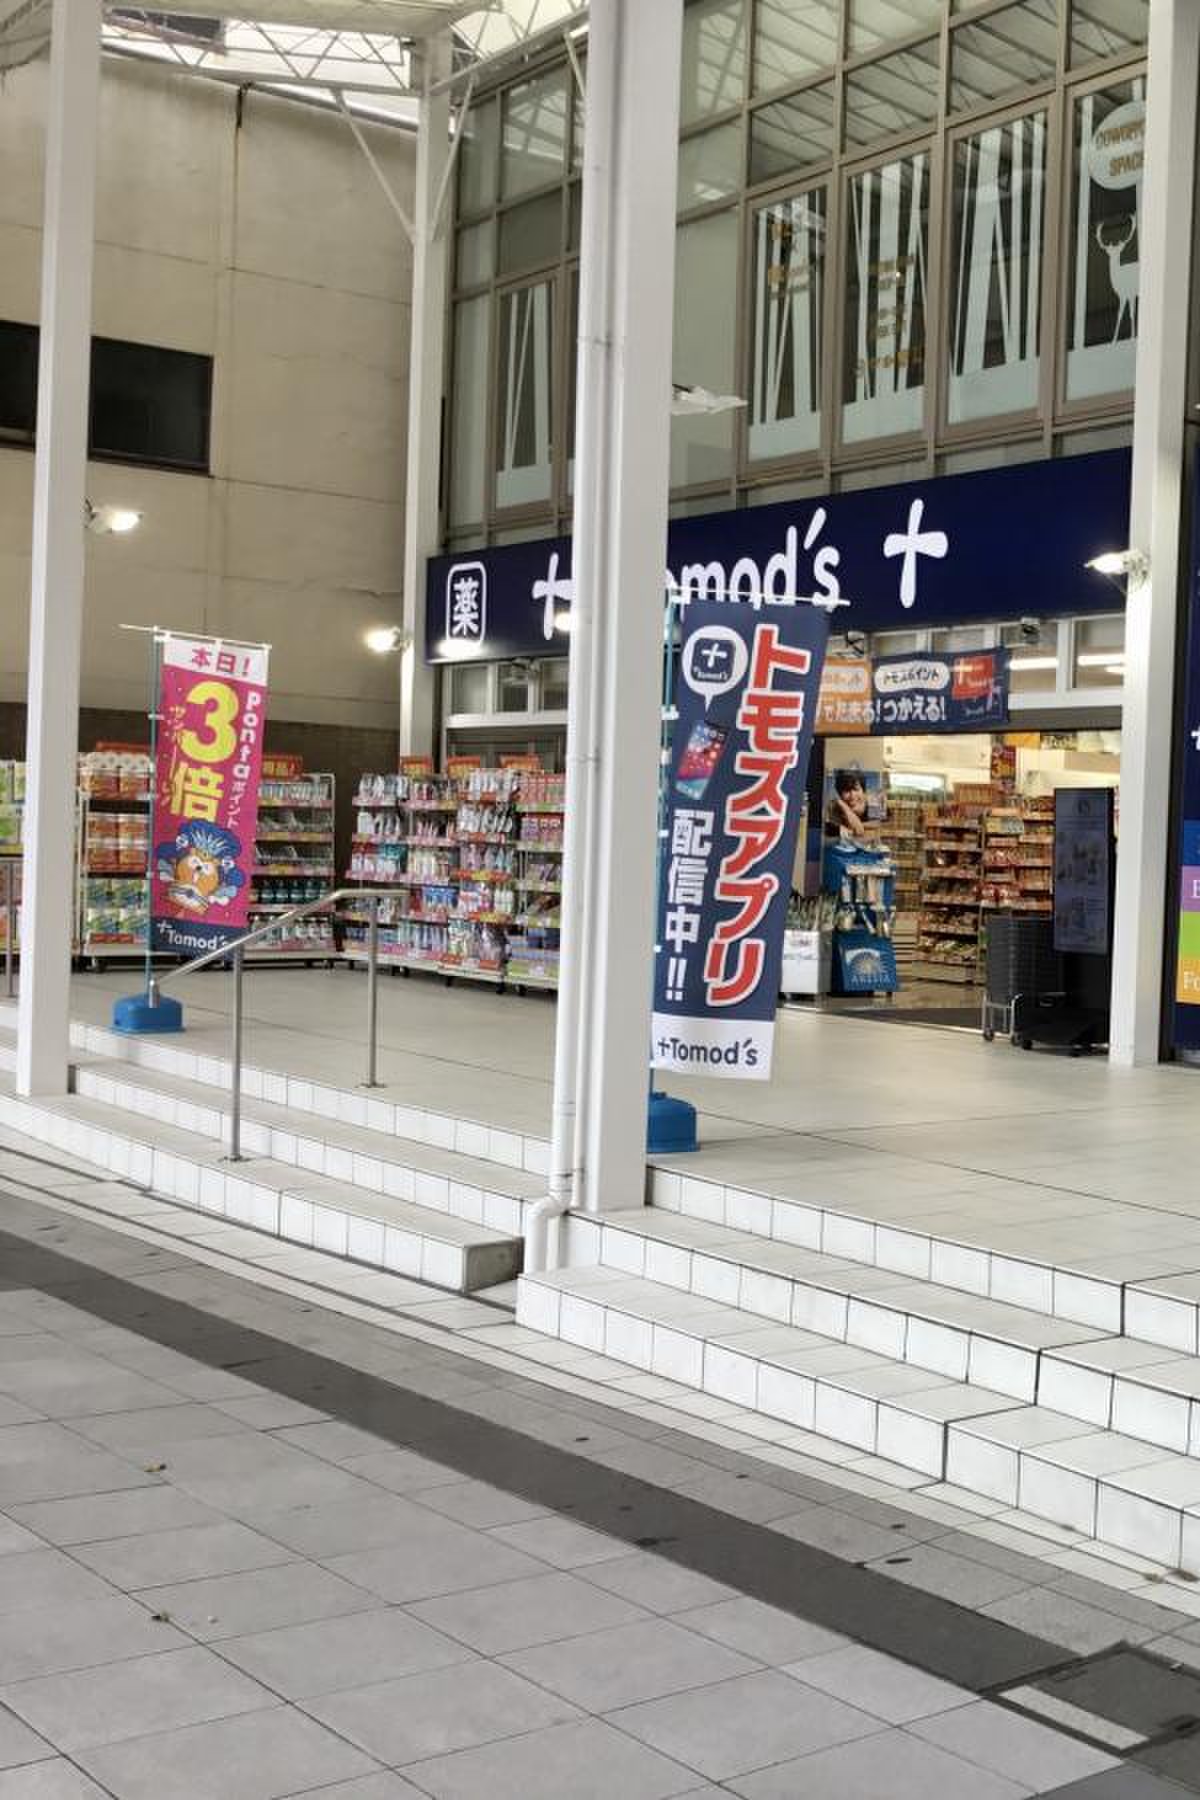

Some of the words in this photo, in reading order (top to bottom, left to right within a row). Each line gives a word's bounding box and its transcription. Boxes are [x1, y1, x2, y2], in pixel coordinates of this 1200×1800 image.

[453, 576, 480, 636] 薬
[190, 647, 251, 676] 本日!
[704, 624, 811, 1006] トモズアプリ
[665, 809, 715, 1002] 配信中!!
[670, 1037, 758, 1066] Tomod's
